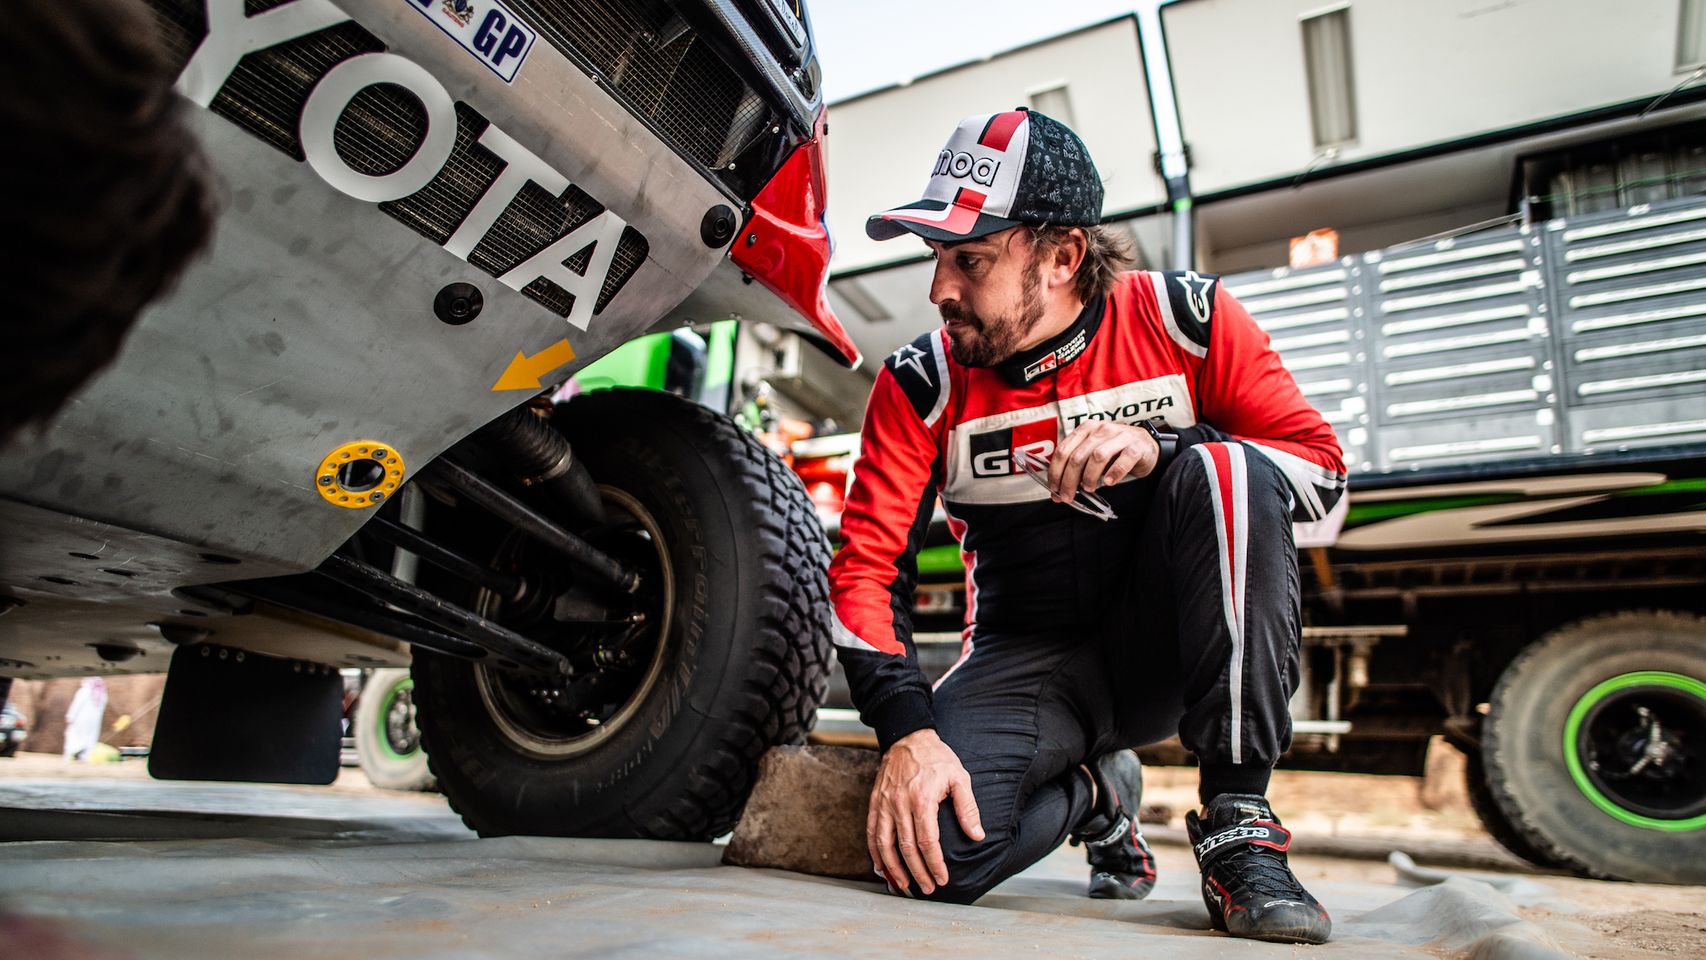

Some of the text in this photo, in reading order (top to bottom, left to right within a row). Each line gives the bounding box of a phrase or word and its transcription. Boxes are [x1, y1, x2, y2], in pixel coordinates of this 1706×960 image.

[473, 8, 527, 66] GP
[177, 0, 627, 332] YOTA
[931, 149, 1001, 187] moa
[974, 439, 1055, 476] GR
[1197, 823, 1270, 862] pinestars
